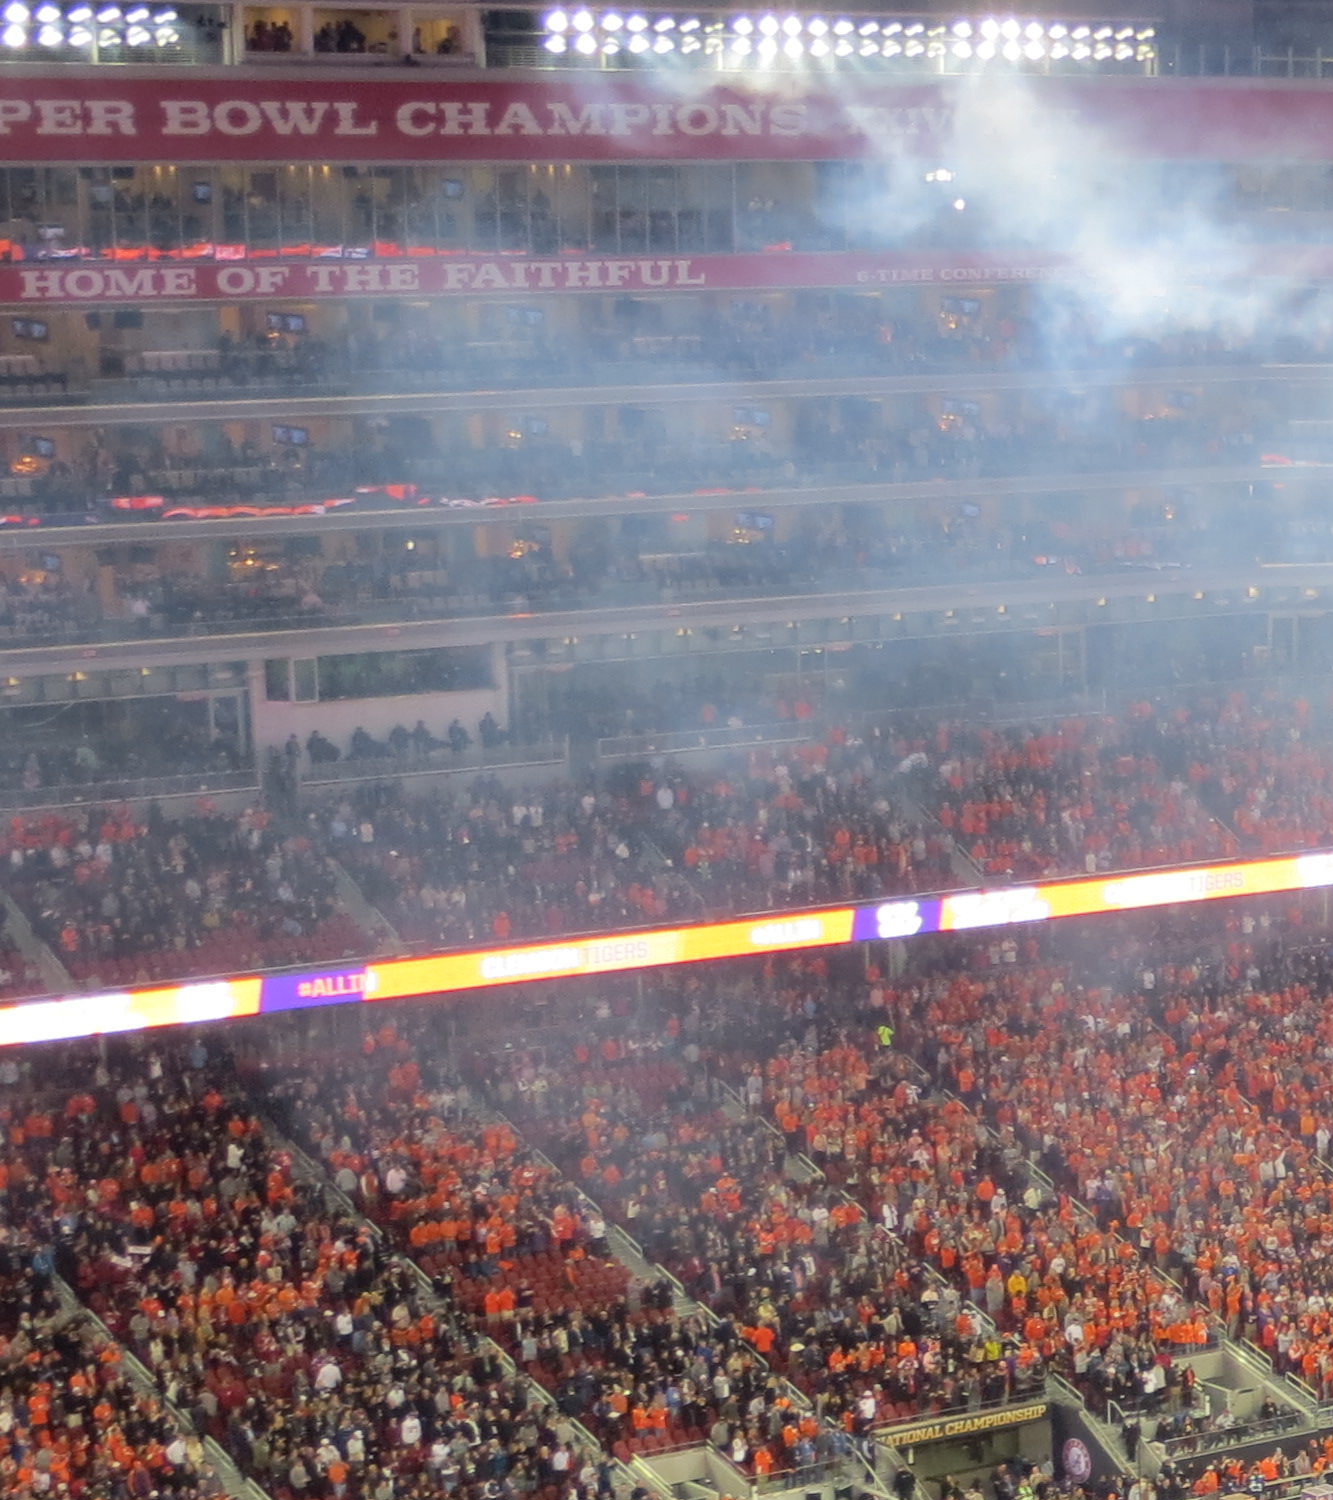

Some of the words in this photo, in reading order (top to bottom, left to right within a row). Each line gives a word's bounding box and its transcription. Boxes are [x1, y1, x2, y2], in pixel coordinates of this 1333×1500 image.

[162, 102, 380, 135] BOWL
[397, 101, 808, 136] CHAMPIONS
[21, 267, 197, 298] HOME
[217, 266, 289, 294] OF
[307, 263, 420, 292] THE
[443, 259, 706, 290] FAITHFUL
[1189, 871, 1244, 893] TIGERS
[581, 941, 648, 968] TIGERS
[876, 1425, 943, 1447] NATIONAL
[944, 1404, 1047, 1436] CHAMPIONSHIP
